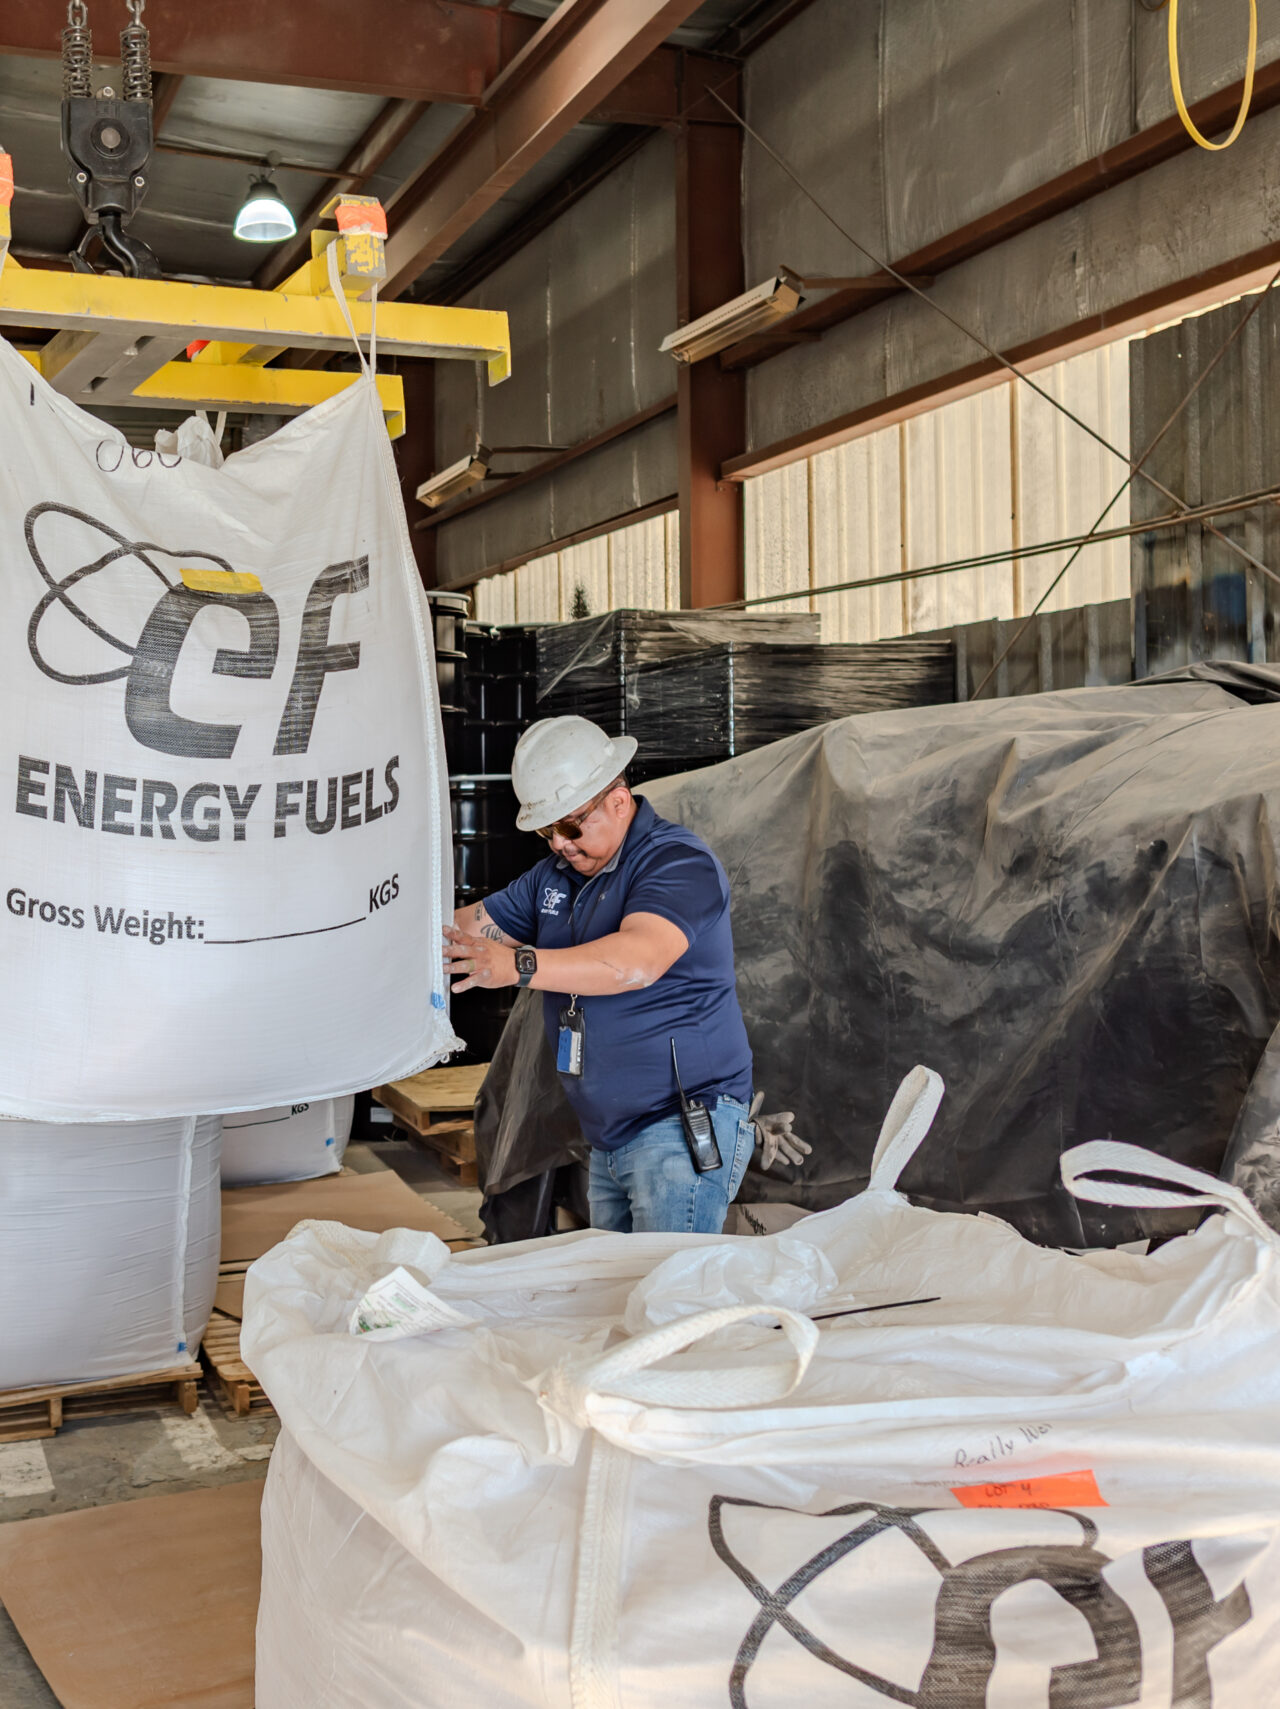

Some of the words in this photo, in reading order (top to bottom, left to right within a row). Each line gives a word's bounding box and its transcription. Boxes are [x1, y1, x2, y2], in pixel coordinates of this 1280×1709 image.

[15, 754, 262, 842] ENERGY
[273, 754, 400, 839] FUELS
[5, 887, 85, 929] Gross
[94, 904, 205, 946] Weight:
[368, 872, 400, 914] KGS
[291, 1102, 310, 1116] KGS
